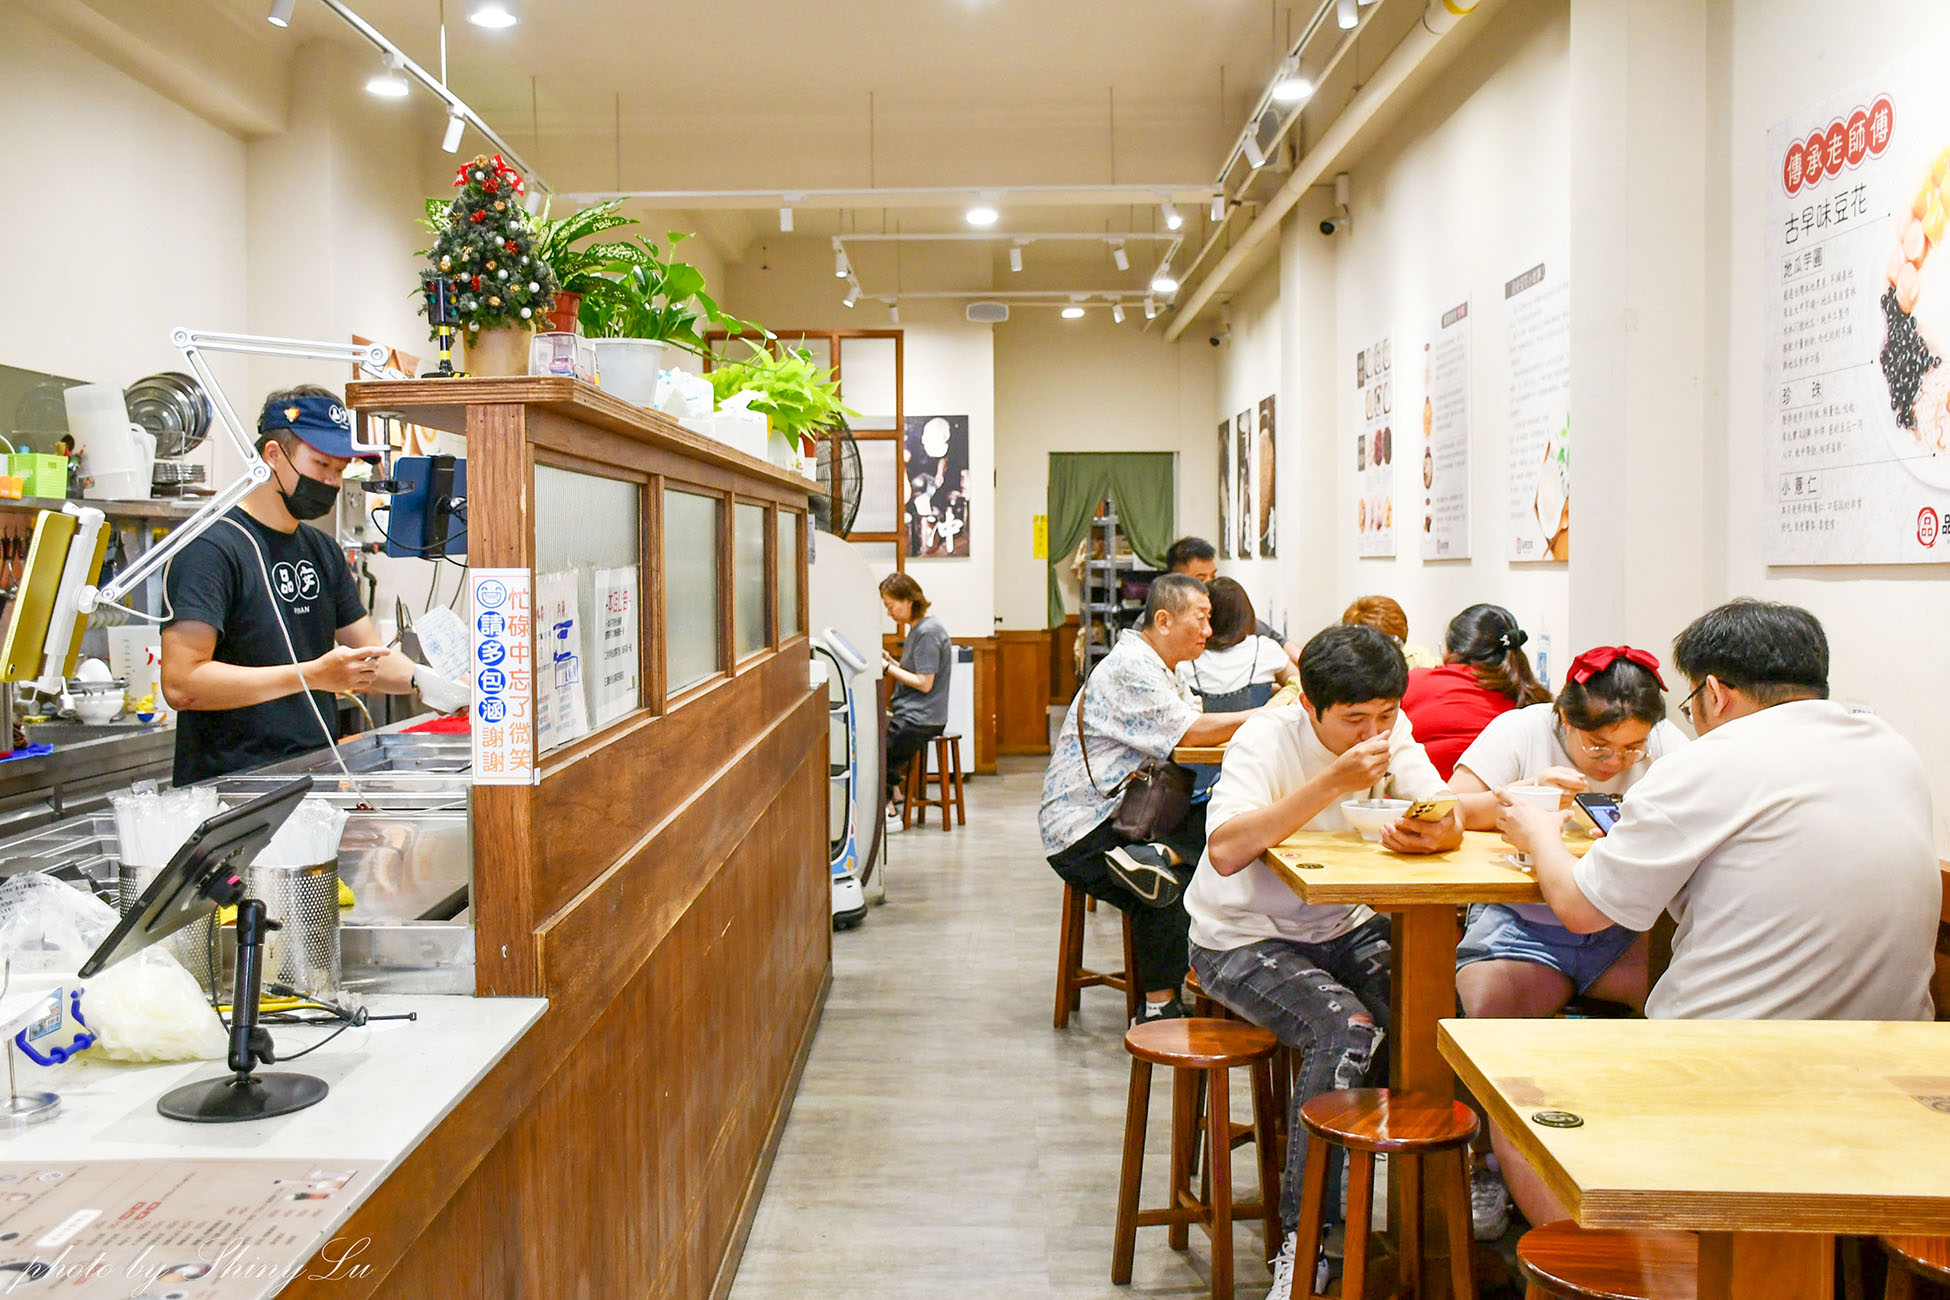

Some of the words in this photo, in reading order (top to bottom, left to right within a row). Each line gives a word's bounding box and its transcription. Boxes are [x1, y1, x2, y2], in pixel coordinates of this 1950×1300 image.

[1787, 109, 1889, 187] 傳承老師傅
[1785, 183, 1867, 245] 古早味豆花
[508, 588, 530, 772] 忙碌中忘了微笑
